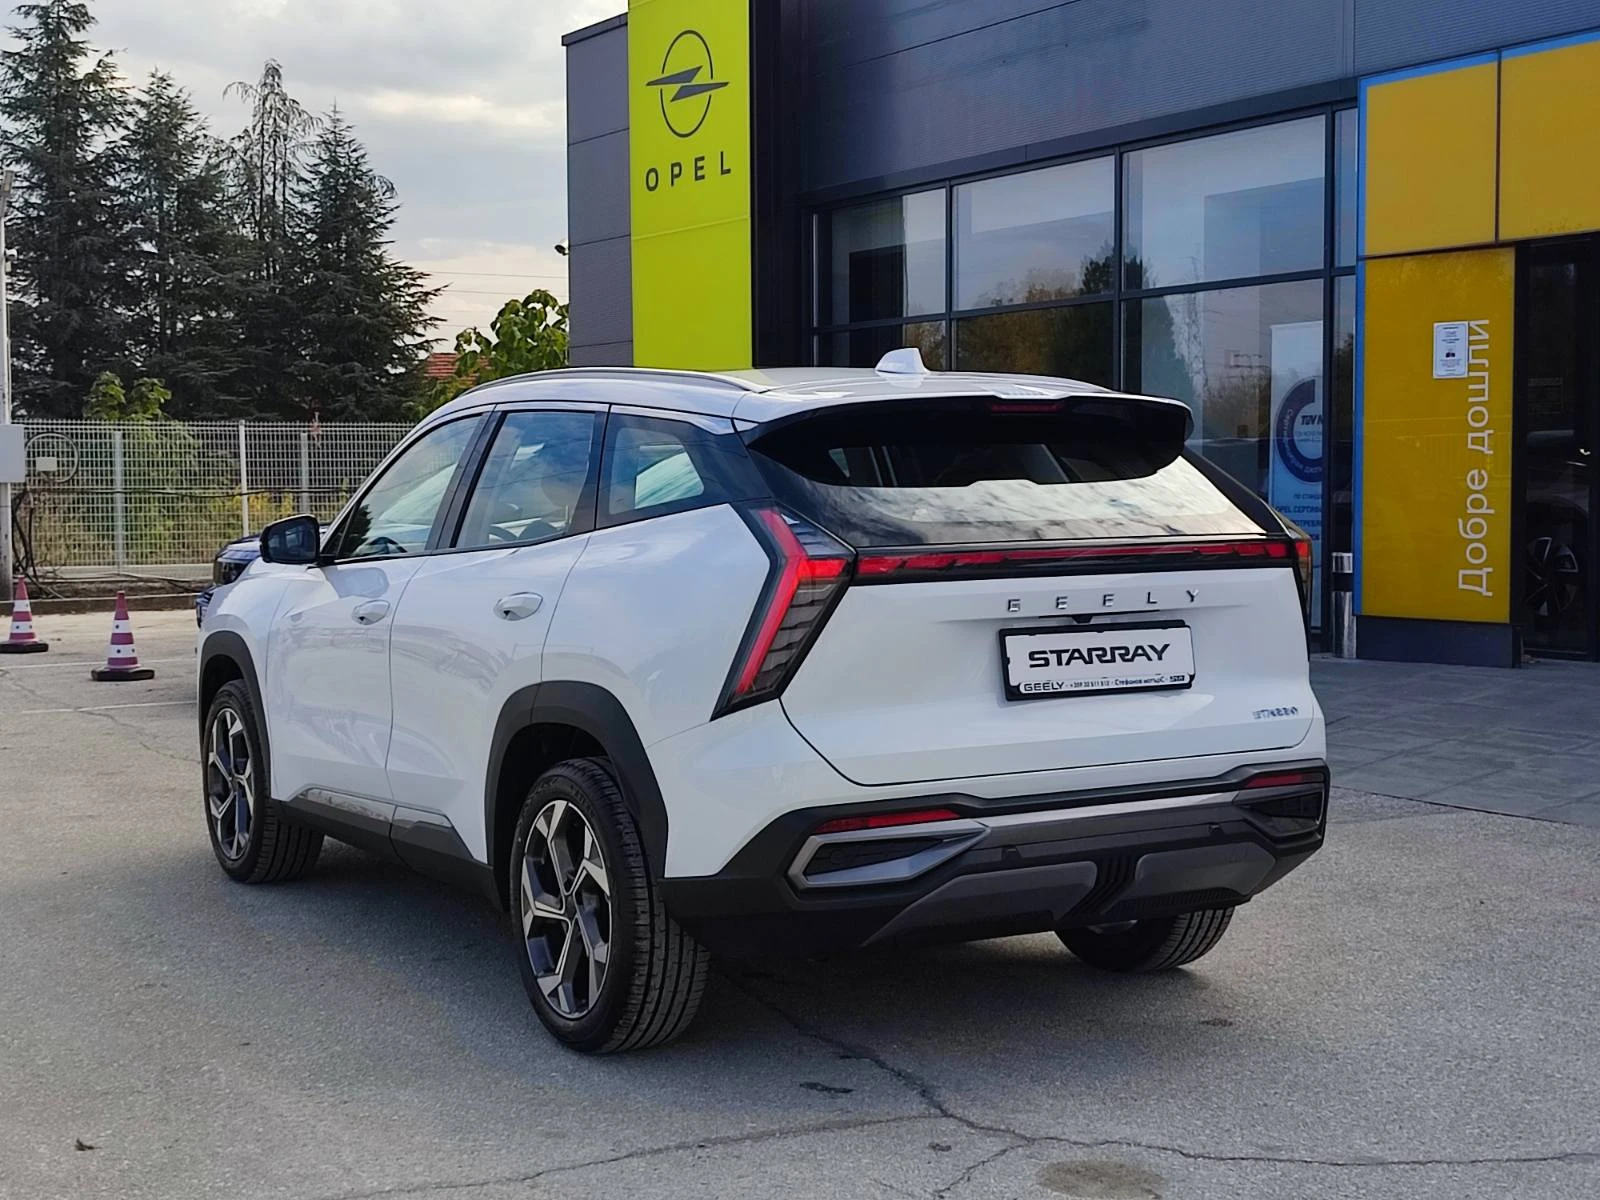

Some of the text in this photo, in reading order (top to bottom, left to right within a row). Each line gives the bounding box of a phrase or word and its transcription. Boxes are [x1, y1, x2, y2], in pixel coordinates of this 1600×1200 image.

[645, 151, 731, 191] OPEL
[1458, 319, 1495, 596] Добре дошли
[1007, 589, 1199, 612] GEELY
[1028, 643, 1170, 668] STARRAY
[1024, 682, 1064, 692] GEELY
